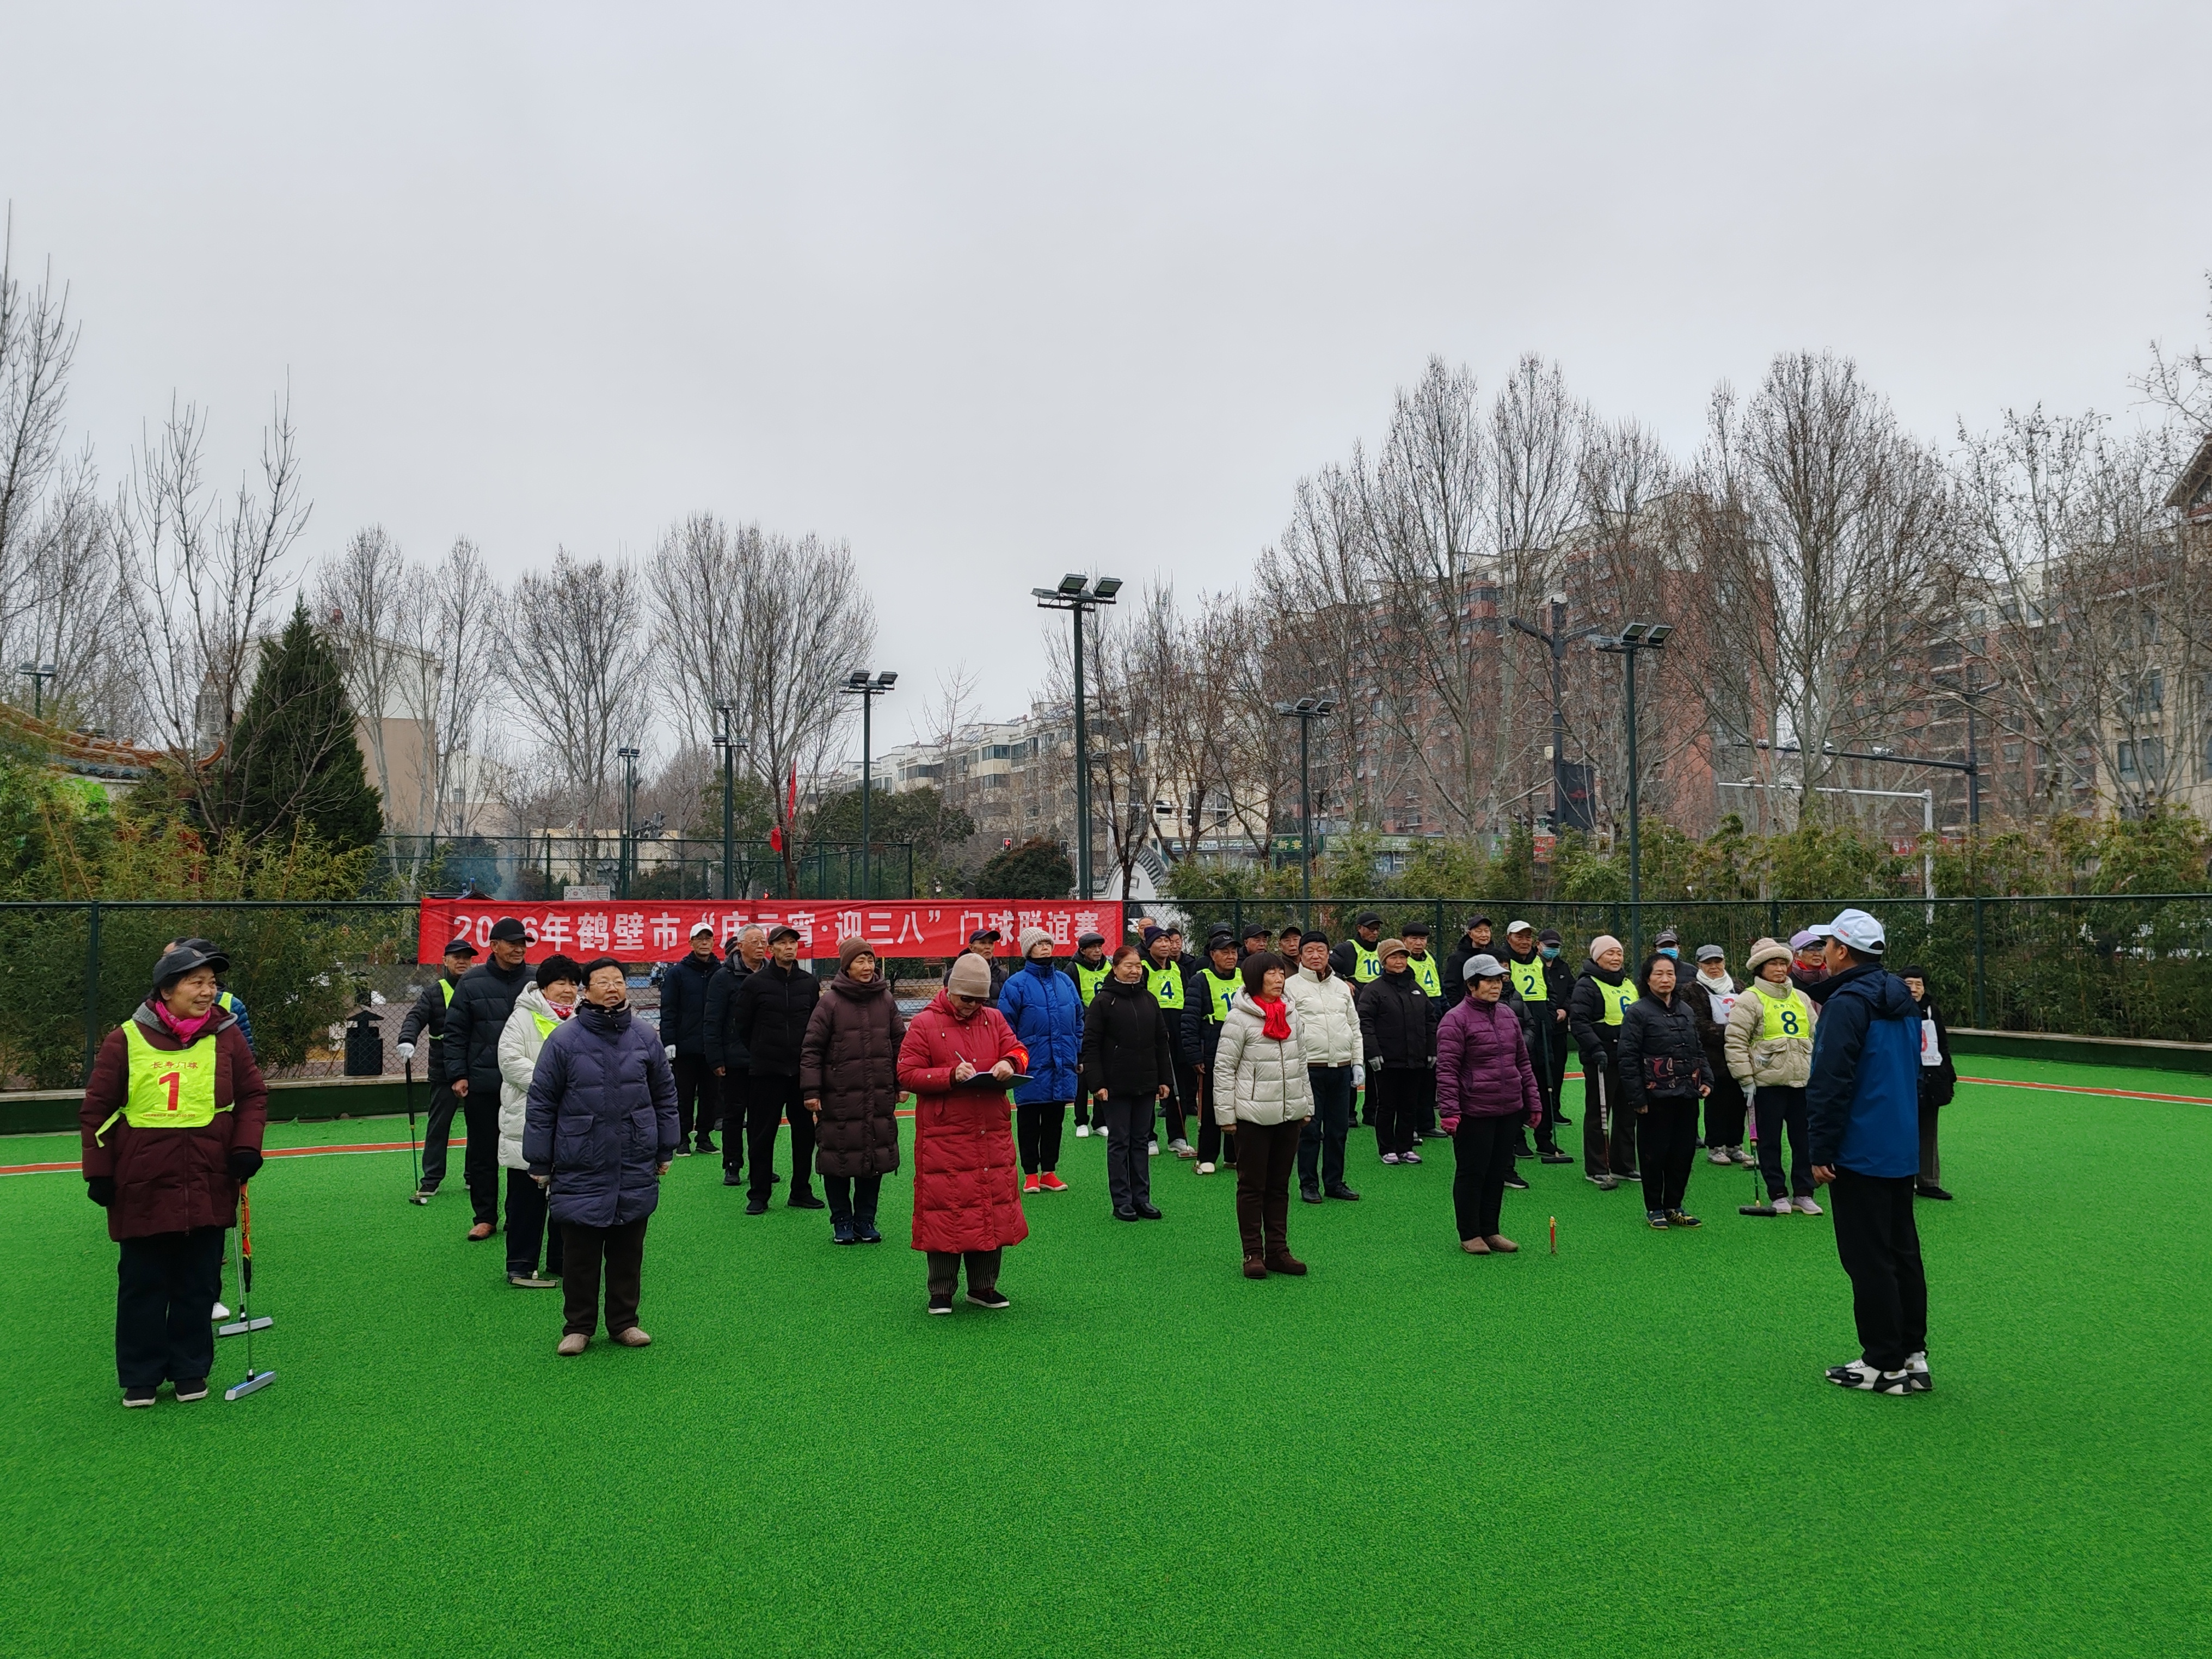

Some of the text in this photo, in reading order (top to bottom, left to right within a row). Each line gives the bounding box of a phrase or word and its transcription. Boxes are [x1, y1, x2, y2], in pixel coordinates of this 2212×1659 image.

[1363, 959, 1383, 976] 10
[1424, 969, 1434, 988] 4
[1523, 975, 1537, 995] 2
[1160, 981, 1175, 999] 4
[1221, 992, 1237, 1012] 1
[1781, 1011, 1799, 1035] 8
[151, 1061, 198, 1069] 长寿门球
[158, 1072, 180, 1111] 1
